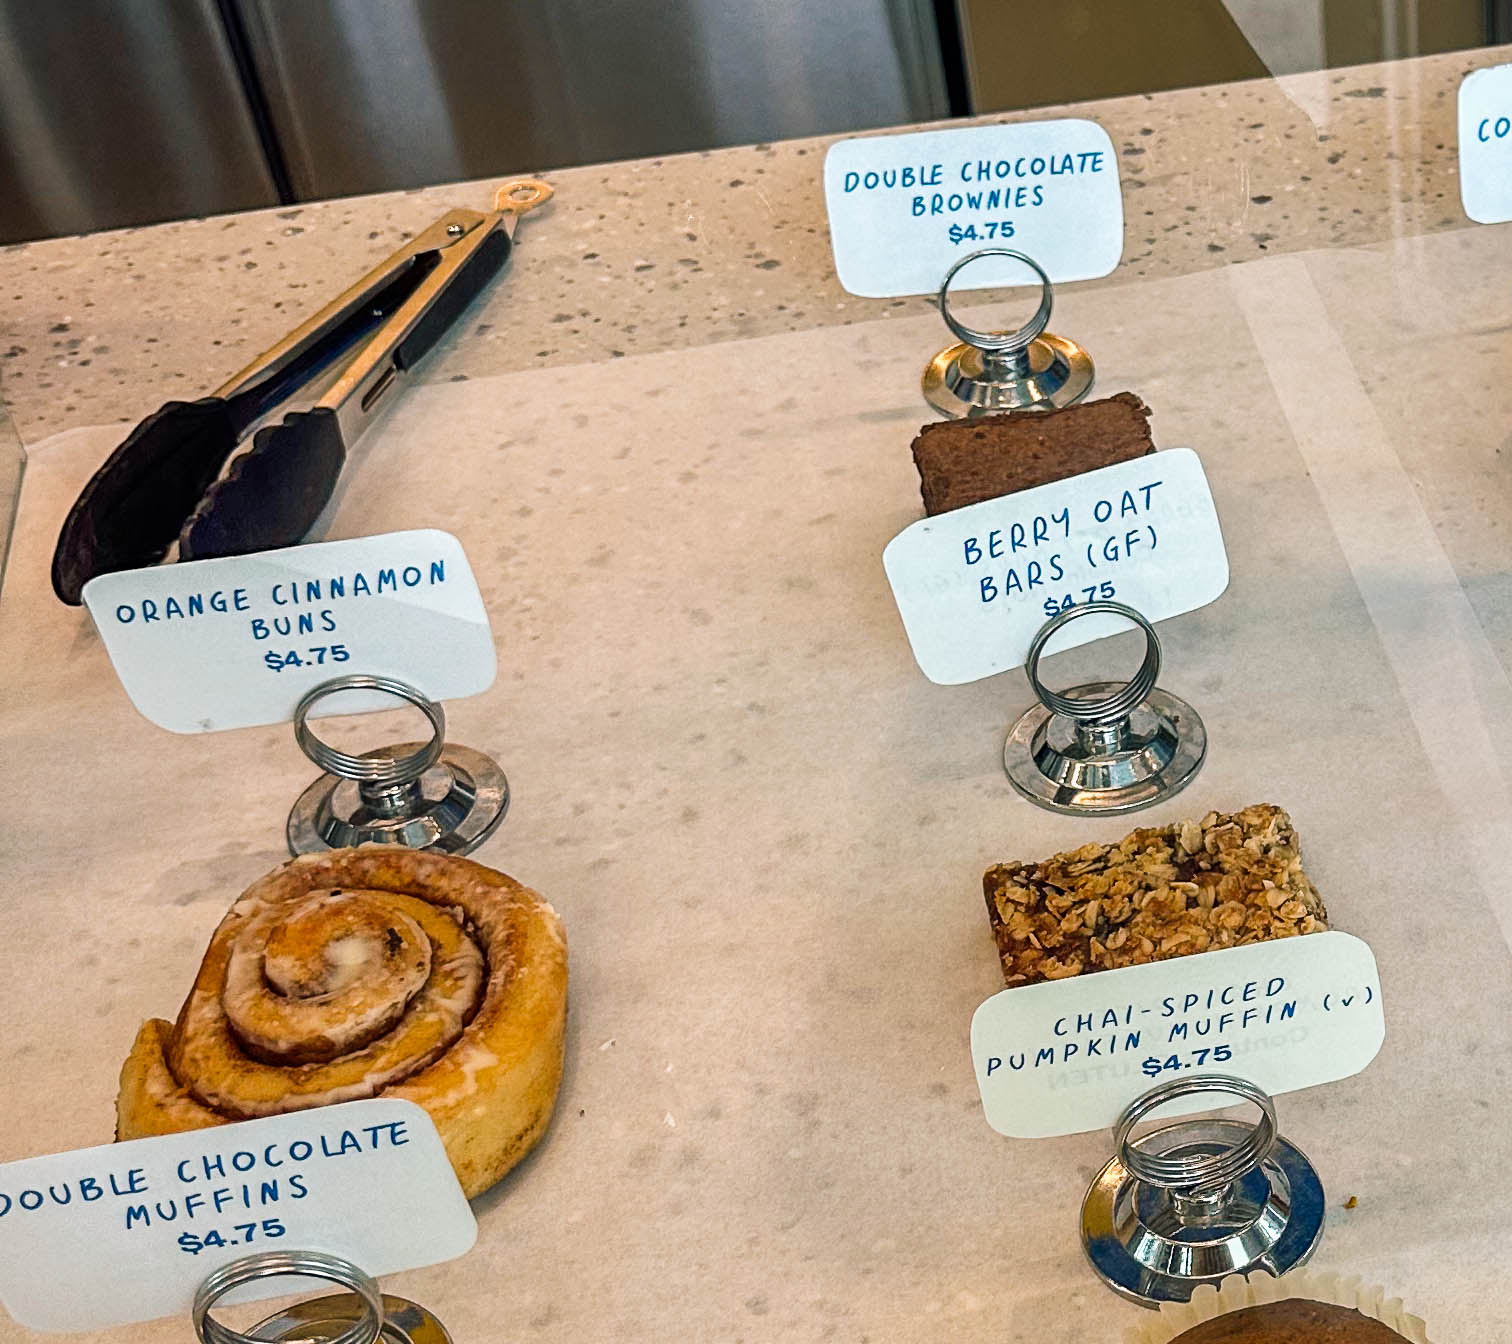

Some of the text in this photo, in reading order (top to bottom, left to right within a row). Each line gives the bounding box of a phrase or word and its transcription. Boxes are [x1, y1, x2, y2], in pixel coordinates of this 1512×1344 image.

[844, 151, 1105, 193] DOUBLE CHOCOLATE
[912, 185, 1044, 216] BROWNIES
[948, 221, 1015, 244] $4.75
[964, 481, 1164, 565] BERRY OAT
[979, 526, 1158, 603] BARS (GF)
[116, 559, 446, 623] ORANGE CINNAMON
[252, 610, 337, 640] BUNS
[265, 645, 350, 672] $4.75
[1054, 977, 1286, 1036] CHAI-SPICED
[987, 1030, 1141, 1077] PUMPKIN
[1168, 1000, 1298, 1043] MUFFIN
[1142, 1045, 1232, 1078] $4.75
[178, 1120, 410, 1182] CHOCOLATE
[126, 1174, 309, 1230] MUFFINS
[178, 1218, 286, 1255] $4.75
